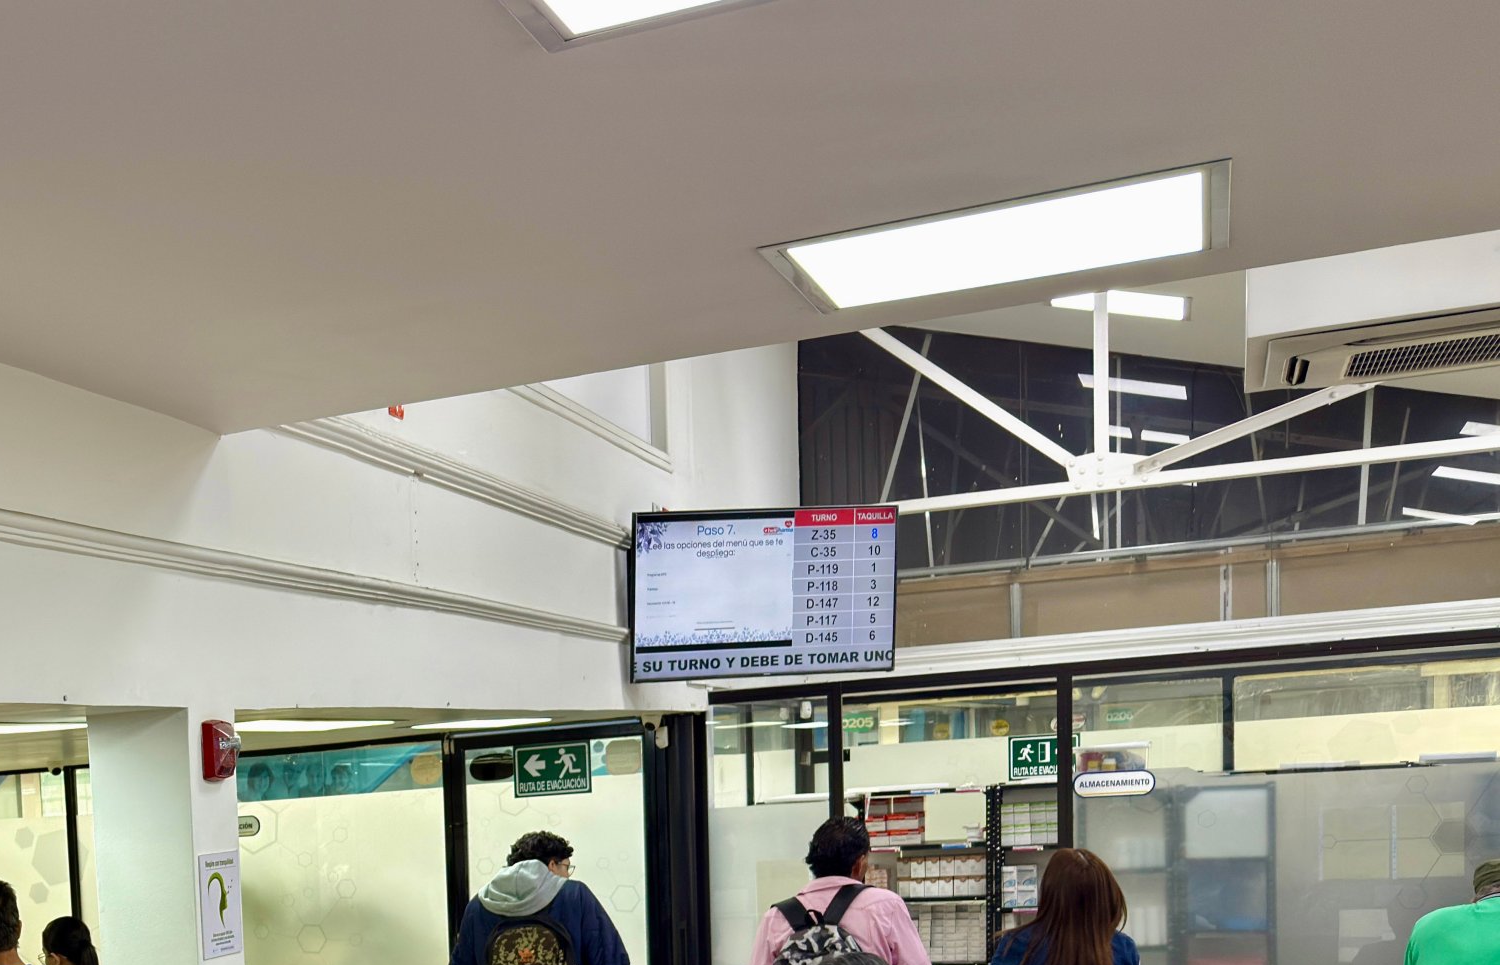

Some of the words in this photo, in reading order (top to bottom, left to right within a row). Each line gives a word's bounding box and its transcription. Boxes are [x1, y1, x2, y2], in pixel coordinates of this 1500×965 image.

[811, 514, 838, 522] TURNO
[857, 512, 894, 520] TAQUILLA
[696, 524, 724, 536] Paso
[727, 524, 736, 535] 7.
[811, 529, 836, 540] Z-35
[871, 528, 878, 539] 8
[663, 540, 676, 550] las
[676, 540, 711, 552] opciones
[712, 539, 725, 548] del
[725, 538, 748, 548] menú
[748, 538, 764, 548] que
[810, 546, 837, 558] C-35
[868, 545, 881, 556] 10
[807, 564, 839, 575] P-119
[871, 562, 877, 572] 1
[807, 581, 838, 592] P-118
[870, 579, 877, 590] 3
[806, 598, 839, 609] D-147
[867, 596, 880, 607] 12
[806, 615, 838, 626] P-117
[869, 613, 876, 624] 5
[805, 632, 838, 643] D-145
[869, 630, 876, 641] 6
[642, 661, 663, 673] SU
[668, 658, 720, 671] TURNO
[726, 657, 735, 668] Y
[740, 655, 779, 668] DEBE
[784, 653, 803, 666] DE
[807, 651, 859, 664] TOMAR
[1013, 766, 1029, 776] RUTA
[1029, 765, 1038, 775] DE
[519, 781, 536, 792] RUTA
[536, 780, 545, 791] DE
[546, 776, 587, 790] EVACUACIÓN
[1079, 778, 1150, 789] ALMACENAMIENTO
